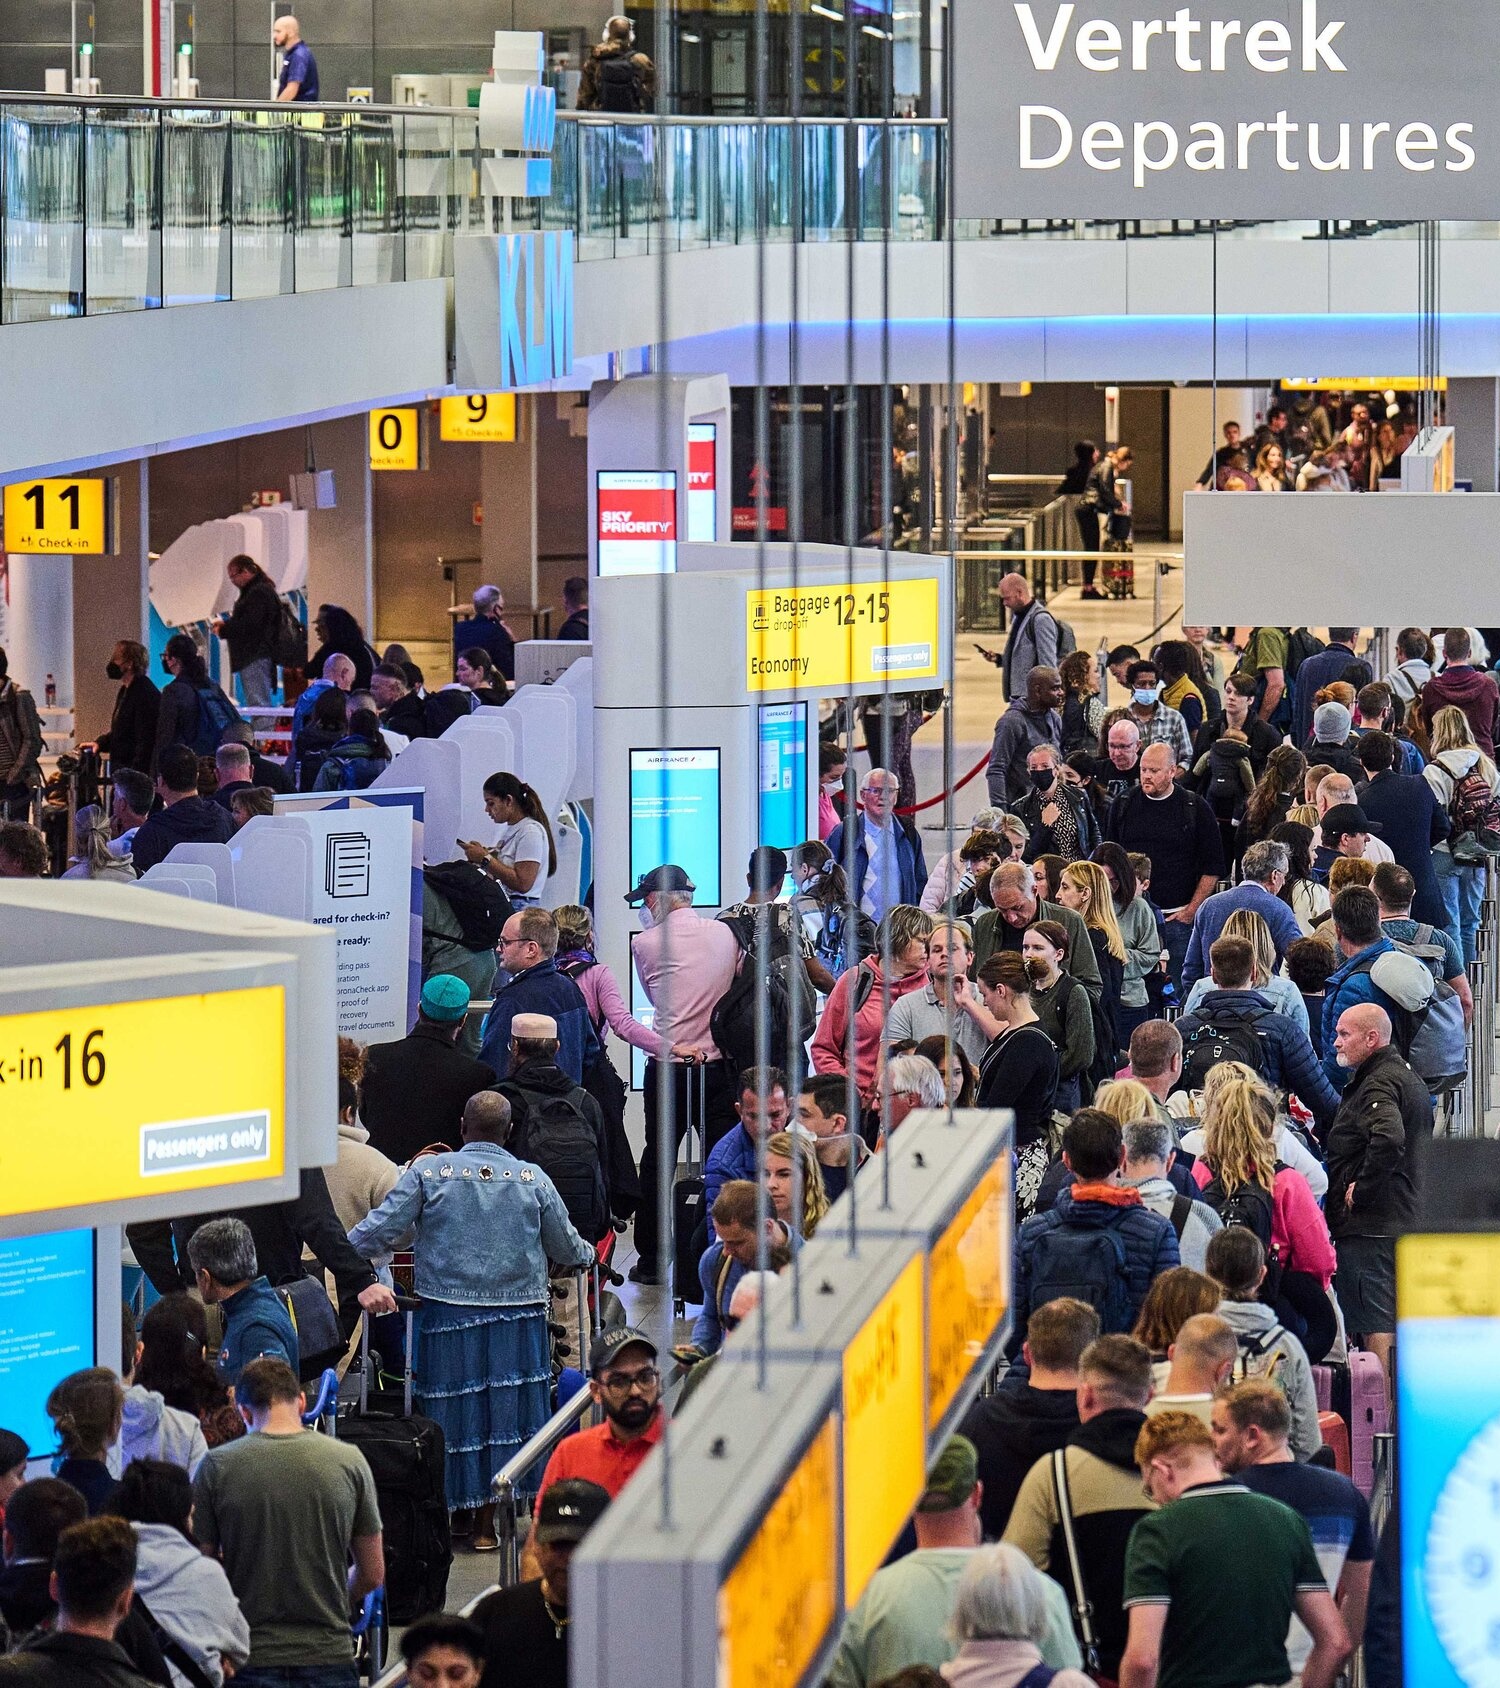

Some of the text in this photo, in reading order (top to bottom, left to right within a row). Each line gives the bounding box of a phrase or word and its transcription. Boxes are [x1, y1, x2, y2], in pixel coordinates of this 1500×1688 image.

[1017, 0, 1348, 72] Vertrek
[1018, 104, 1476, 188] Departures
[498, 230, 573, 389] KLM
[467, 394, 488, 423] 9
[378, 414, 402, 450] 0
[370, 456, 404, 465] heck-in
[23, 485, 81, 531] 11
[602, 511, 632, 522] SKY
[602, 521, 671, 534] PRIORITY
[38, 536, 90, 550] Check-in
[774, 592, 890, 626] Baggage 12-15
[774, 615, 809, 632] drop-off
[874, 649, 929, 665] Passengers only
[751, 656, 810, 675] Economy
[313, 911, 391, 925] ared for check-in?
[343, 936, 371, 947] ready:
[337, 962, 370, 972] ding pass
[376, 984, 390, 994] app
[341, 997, 369, 1008] proof of
[340, 1011, 368, 1020] recovery
[338, 1020, 395, 1032] travel documents
[0, 1029, 107, 1090] k-in 16
[147, 1123, 265, 1161] Passengers only
[1462, 1546, 1493, 1588] 9
